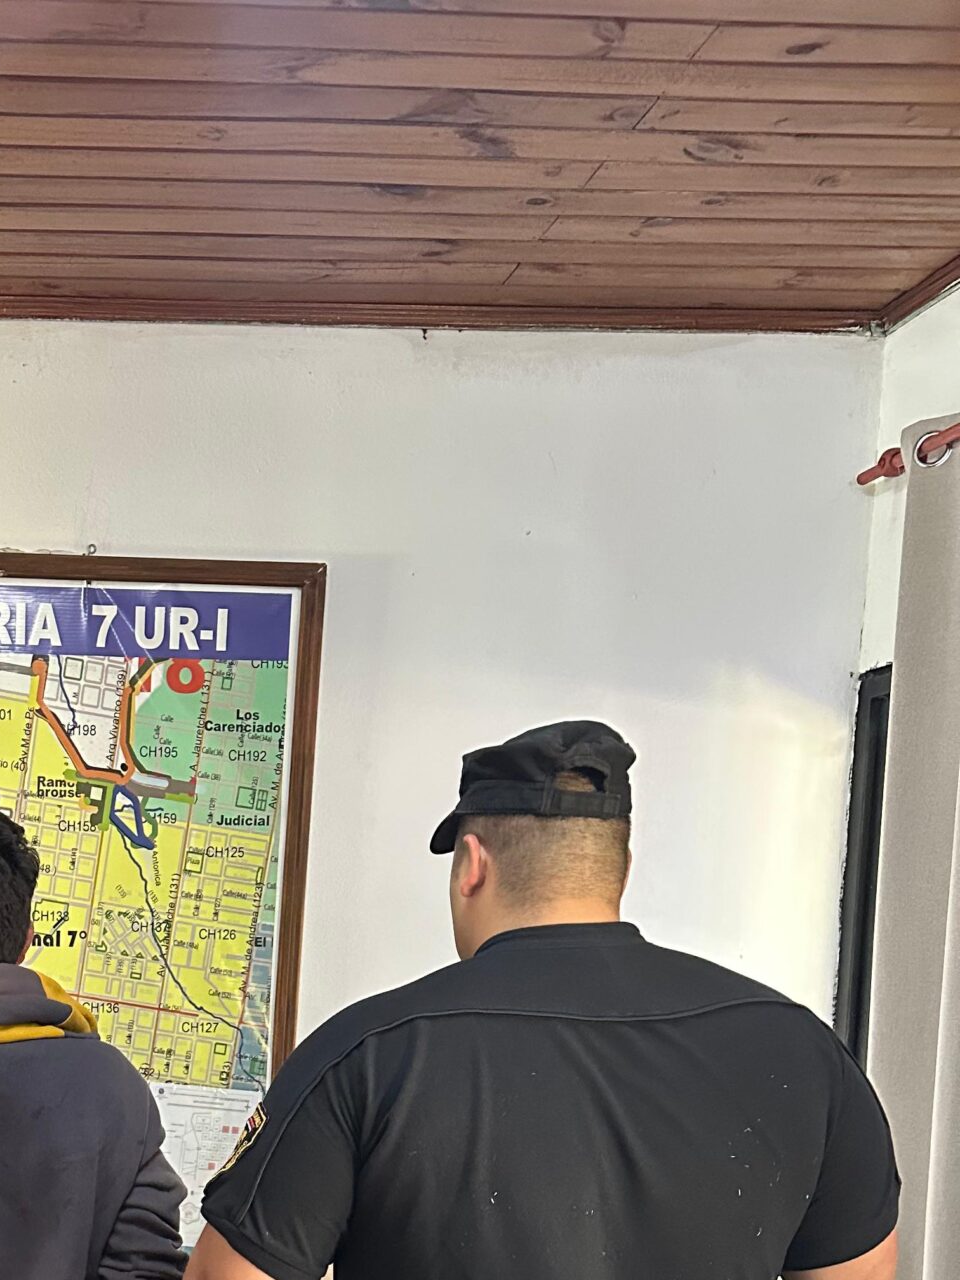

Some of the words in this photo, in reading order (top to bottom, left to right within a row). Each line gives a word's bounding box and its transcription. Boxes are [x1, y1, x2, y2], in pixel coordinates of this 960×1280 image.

[91, 604, 117, 648] 7
[134, 606, 228, 652] UR-I
[115, 669, 127, 697] (139)
[109, 700, 122, 740] Vivanco
[236, 709, 260, 721] Los
[61, 723, 97, 736] H198
[192, 705, 207, 757] Jauretche
[139, 745, 179, 758] CH195
[228, 749, 267, 762] CH192
[141, 812, 178, 824] H159
[216, 815, 270, 827] Judicial
[206, 846, 245, 858] CH125
[169, 873, 182, 899] (131)
[198, 928, 237, 941] CH126
[246, 911, 259, 946] Andrea
[254, 936, 266, 948] El
[181, 1022, 219, 1033] CH127
